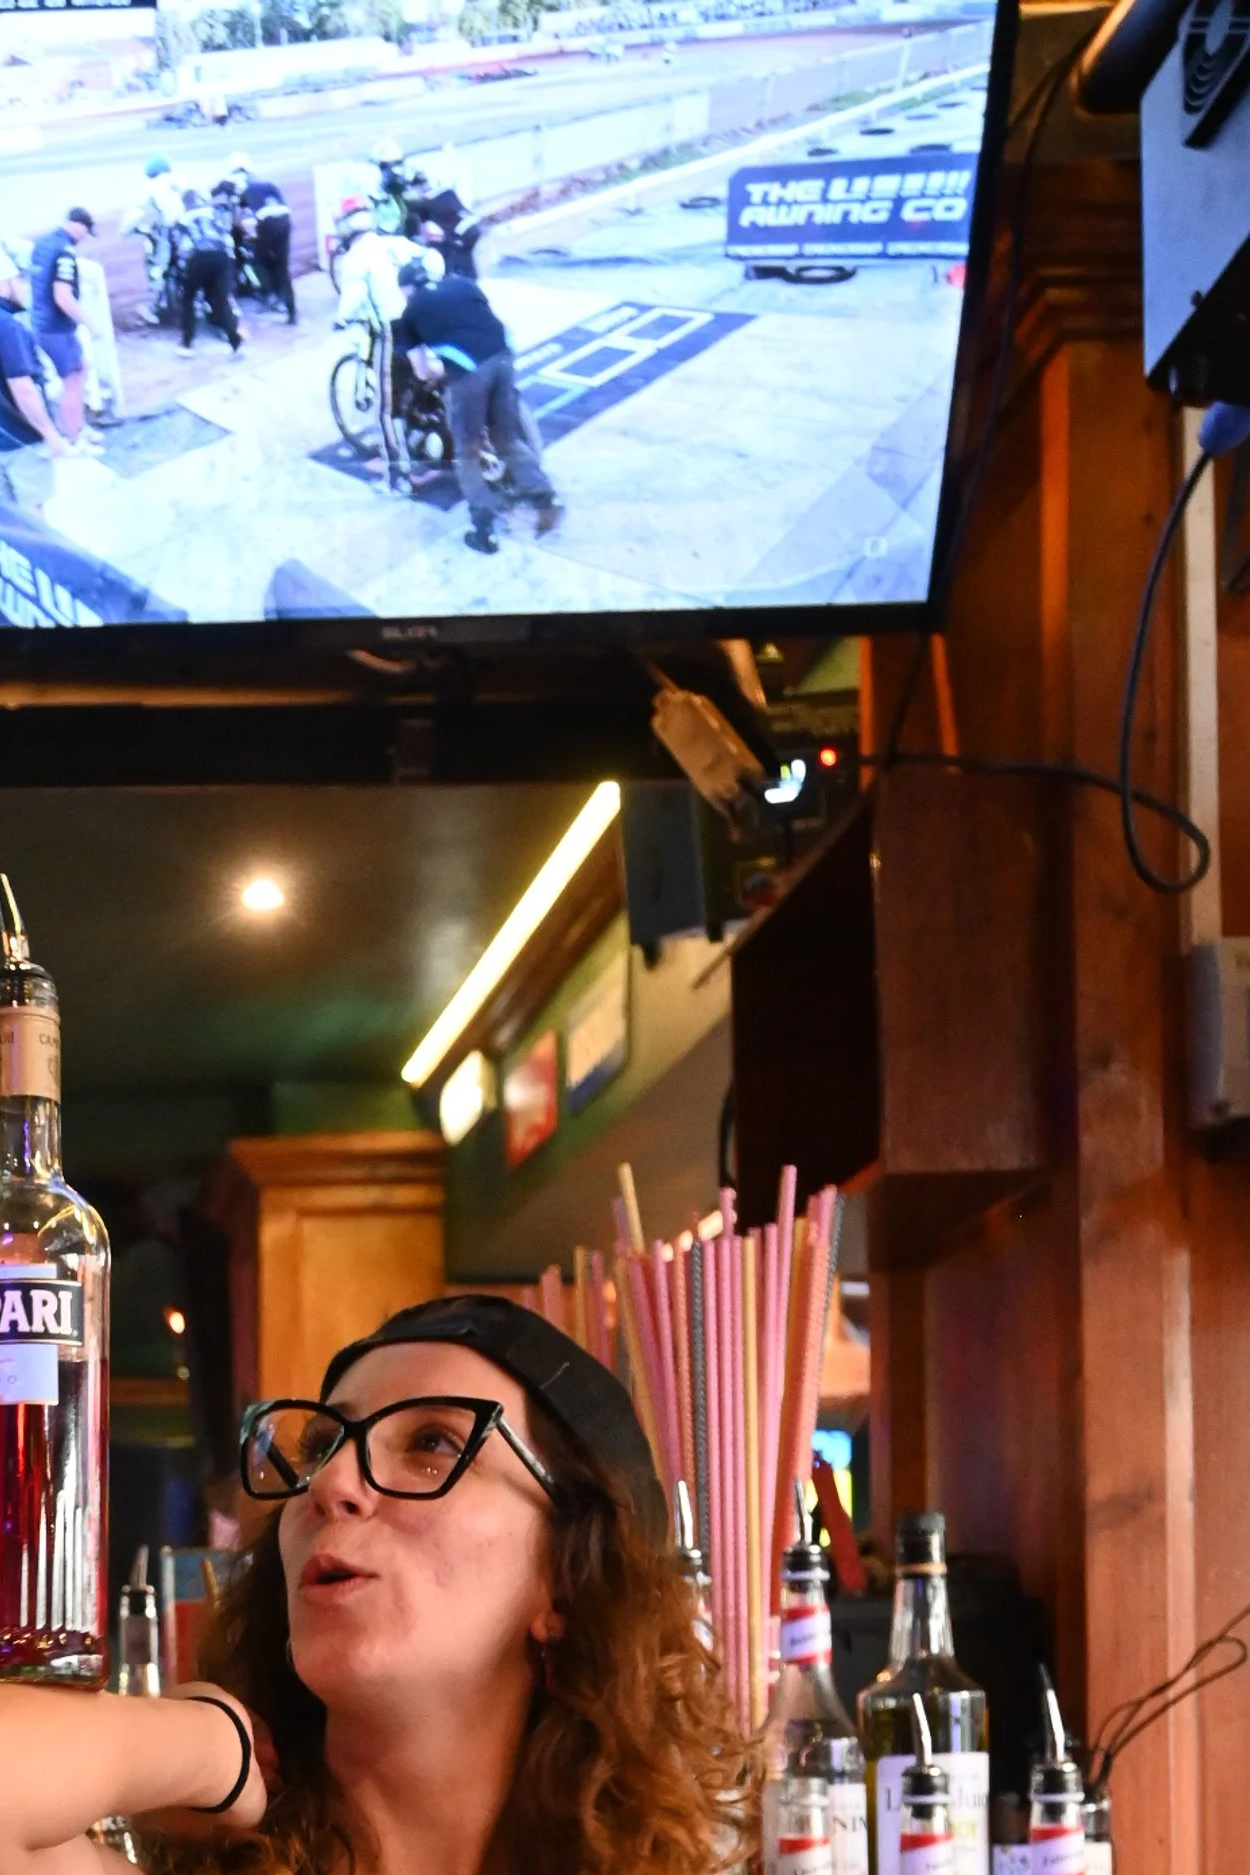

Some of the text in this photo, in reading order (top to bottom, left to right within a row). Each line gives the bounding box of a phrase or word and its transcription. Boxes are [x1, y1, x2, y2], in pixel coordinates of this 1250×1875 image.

[745, 178, 825, 205] THE
[738, 196, 967, 227] AWNING CO
